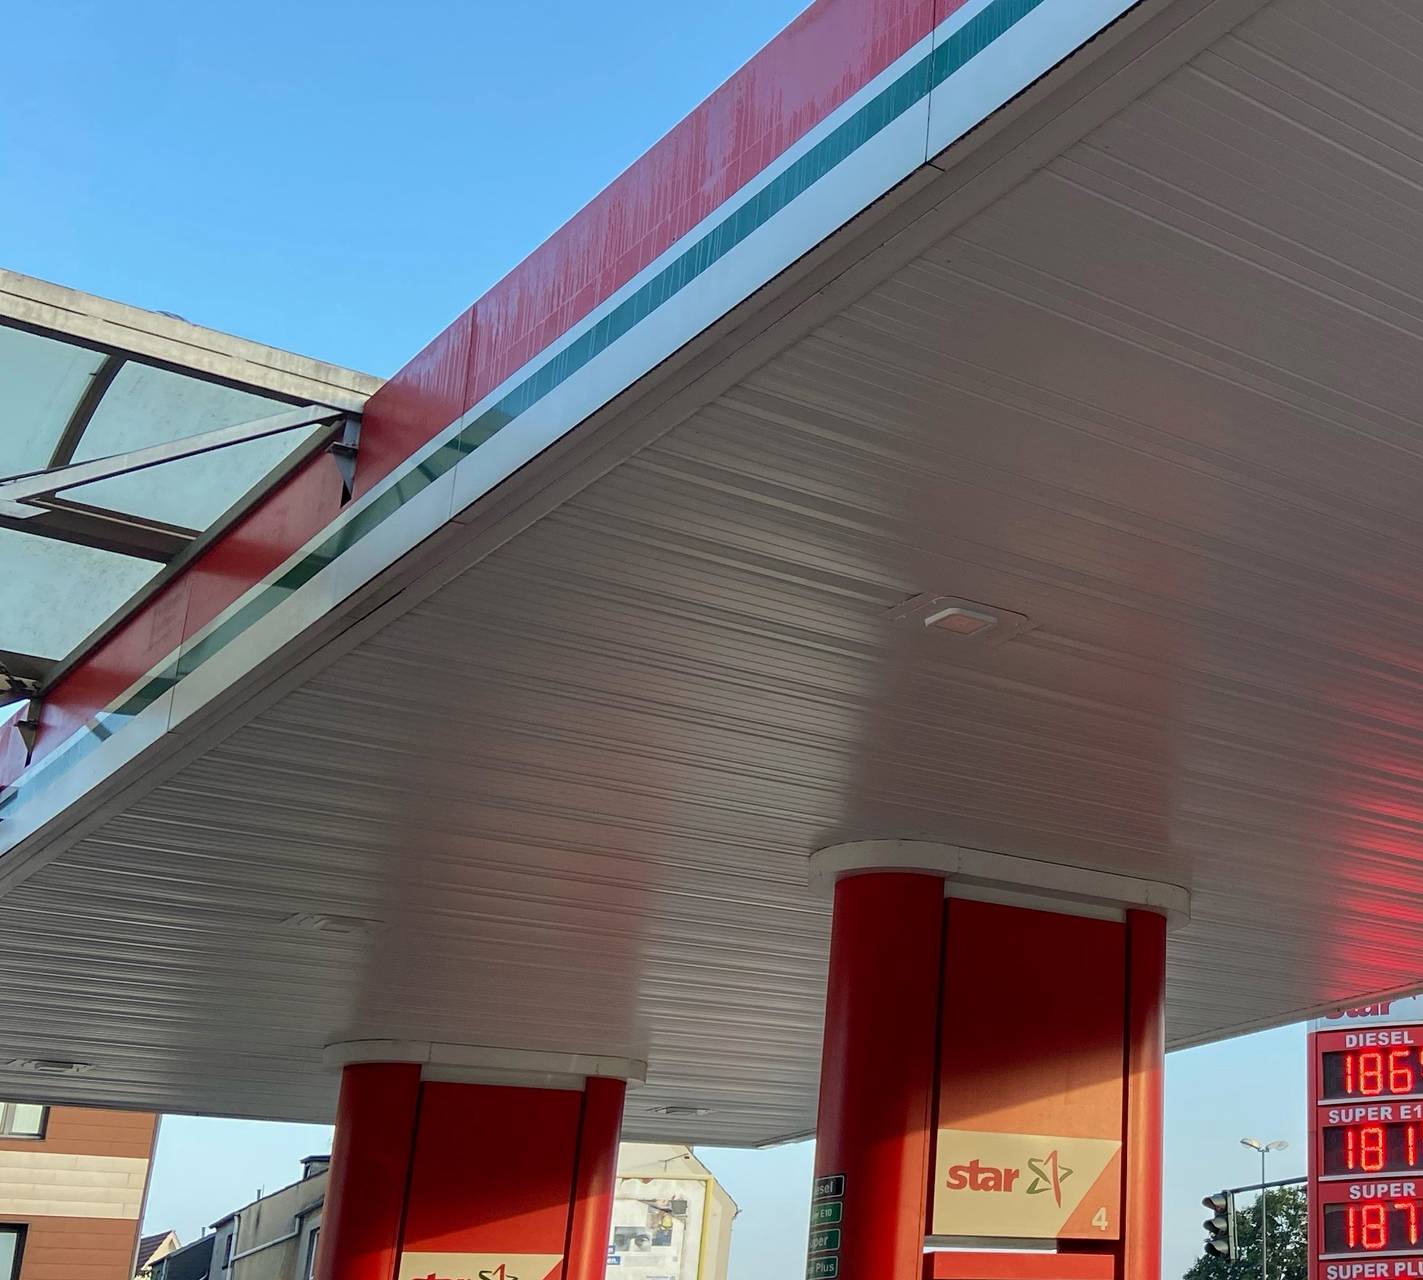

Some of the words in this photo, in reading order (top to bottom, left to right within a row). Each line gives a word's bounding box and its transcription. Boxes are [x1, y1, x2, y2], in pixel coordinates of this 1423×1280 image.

[1345, 1031, 1414, 1048] DIESEL
[1328, 1106, 1393, 1124] SUPER
[946, 1159, 1020, 1192] star
[1349, 1182, 1416, 1200] SUPER
[1091, 1207, 1108, 1230] 4
[1327, 1263, 1389, 1280] SUPER
